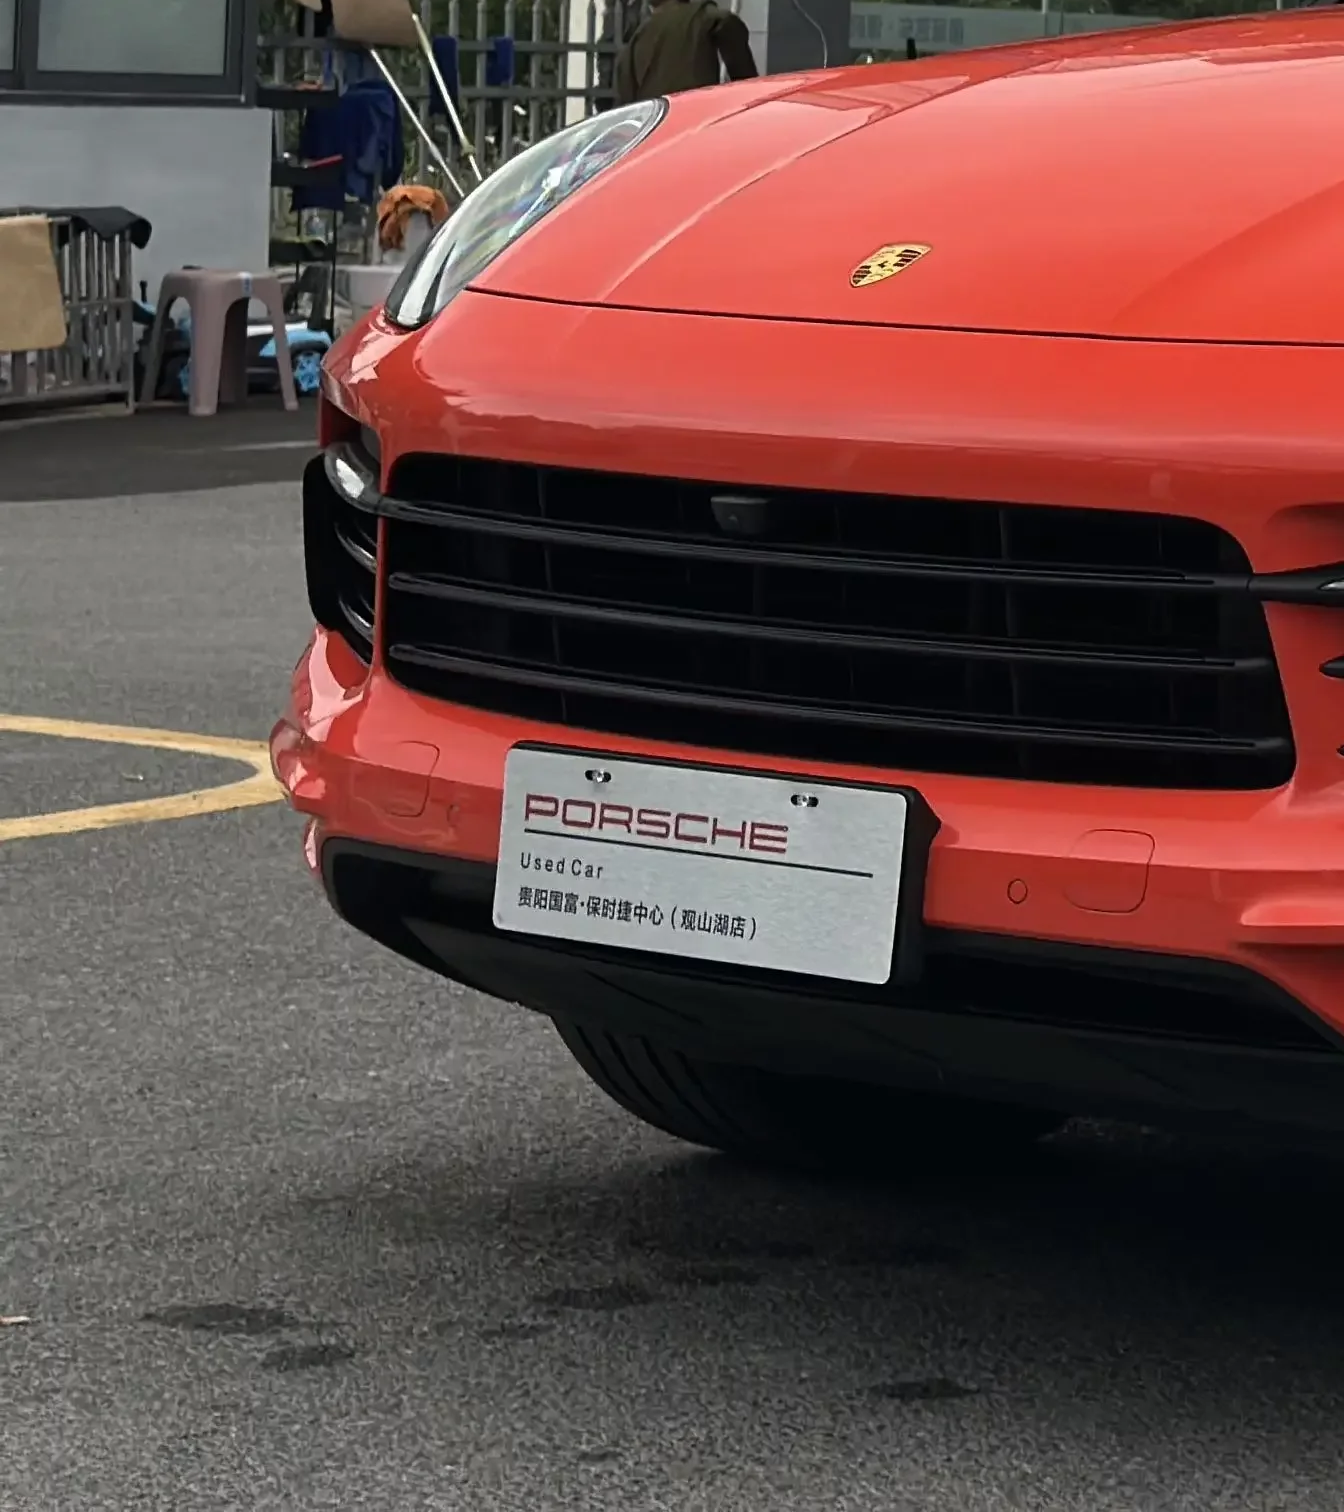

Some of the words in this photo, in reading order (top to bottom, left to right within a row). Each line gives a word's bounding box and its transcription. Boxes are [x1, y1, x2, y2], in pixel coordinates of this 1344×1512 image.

[525, 793, 789, 854] PORSCHE
[520, 852, 566, 876] Used
[571, 858, 604, 882] Car
